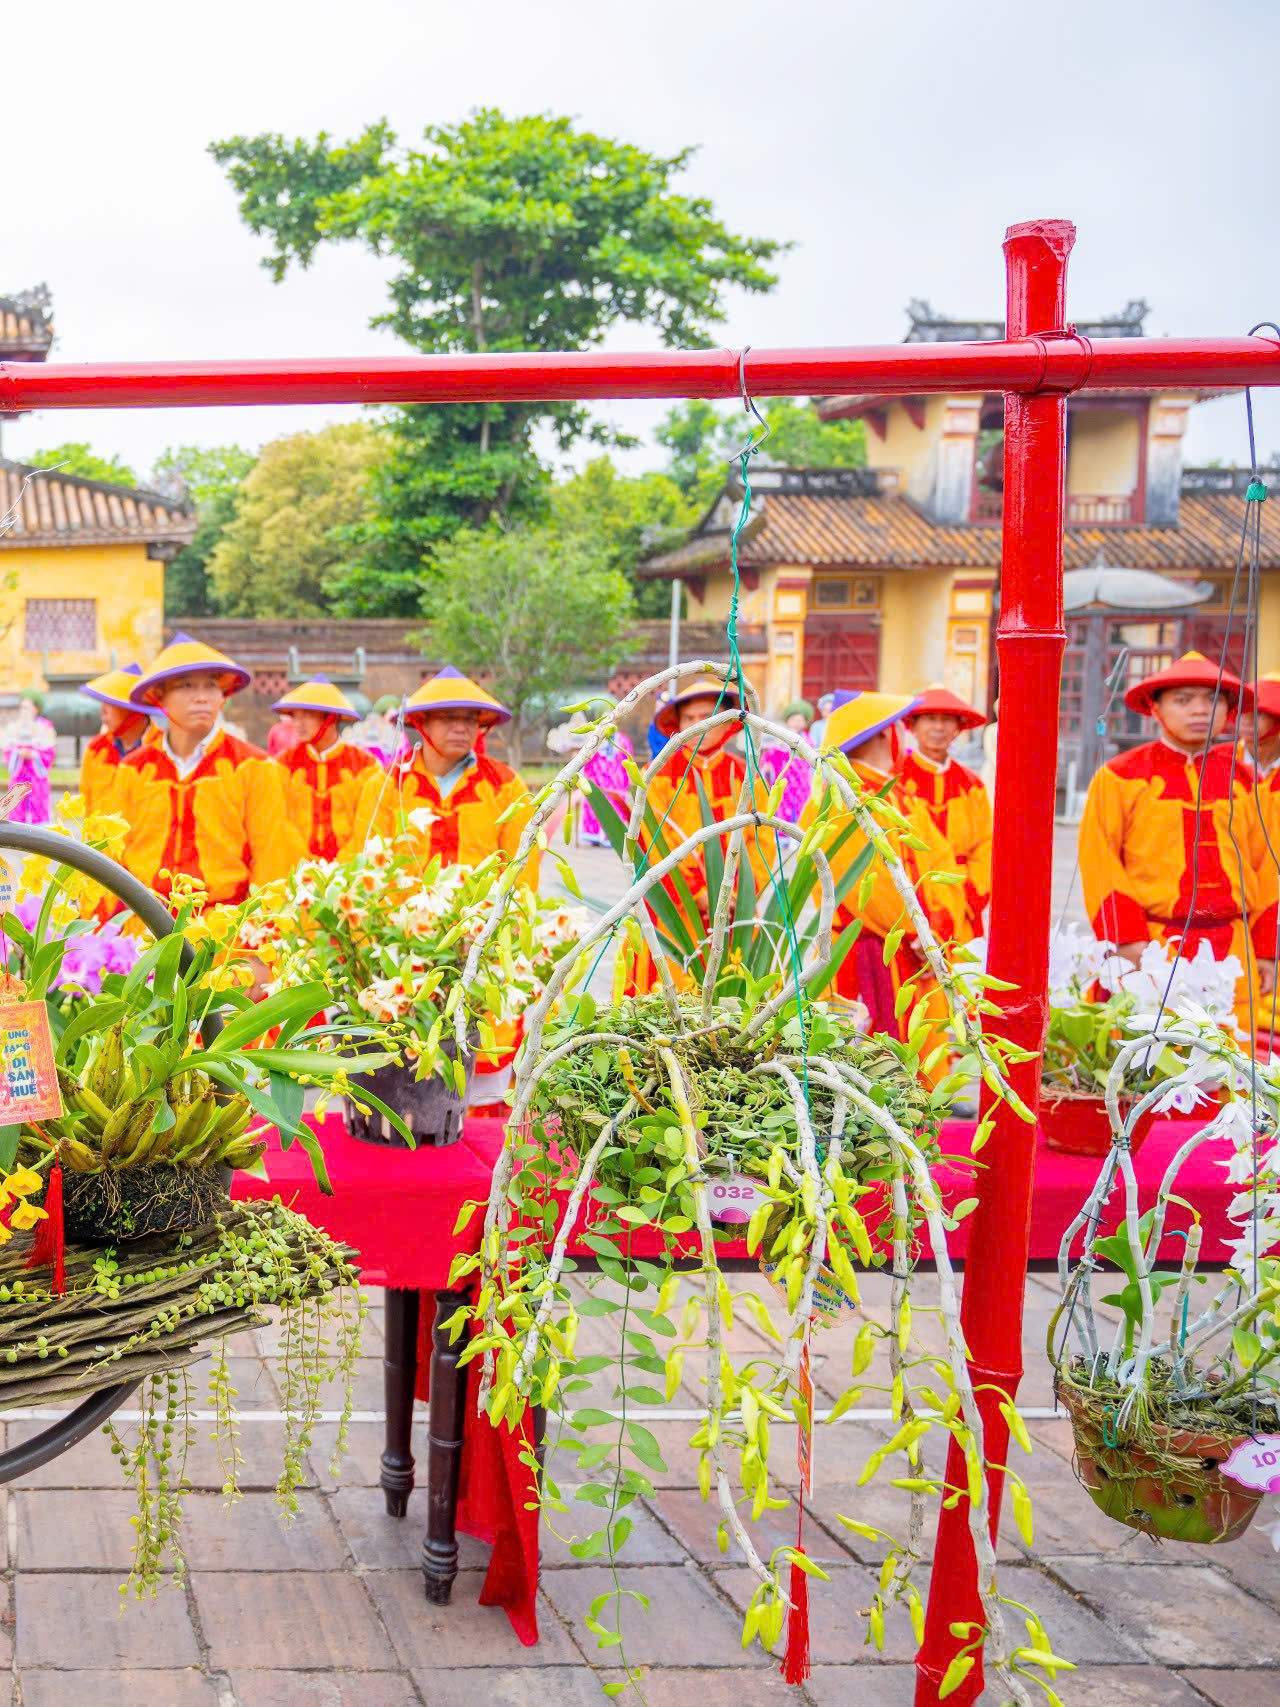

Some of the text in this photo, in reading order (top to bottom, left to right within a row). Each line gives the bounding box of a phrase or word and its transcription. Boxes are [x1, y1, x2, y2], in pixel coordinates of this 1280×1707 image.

[8, 1030, 28, 1039] UNG
[12, 1056, 27, 1069] DI
[713, 1185, 755, 1199] 032
